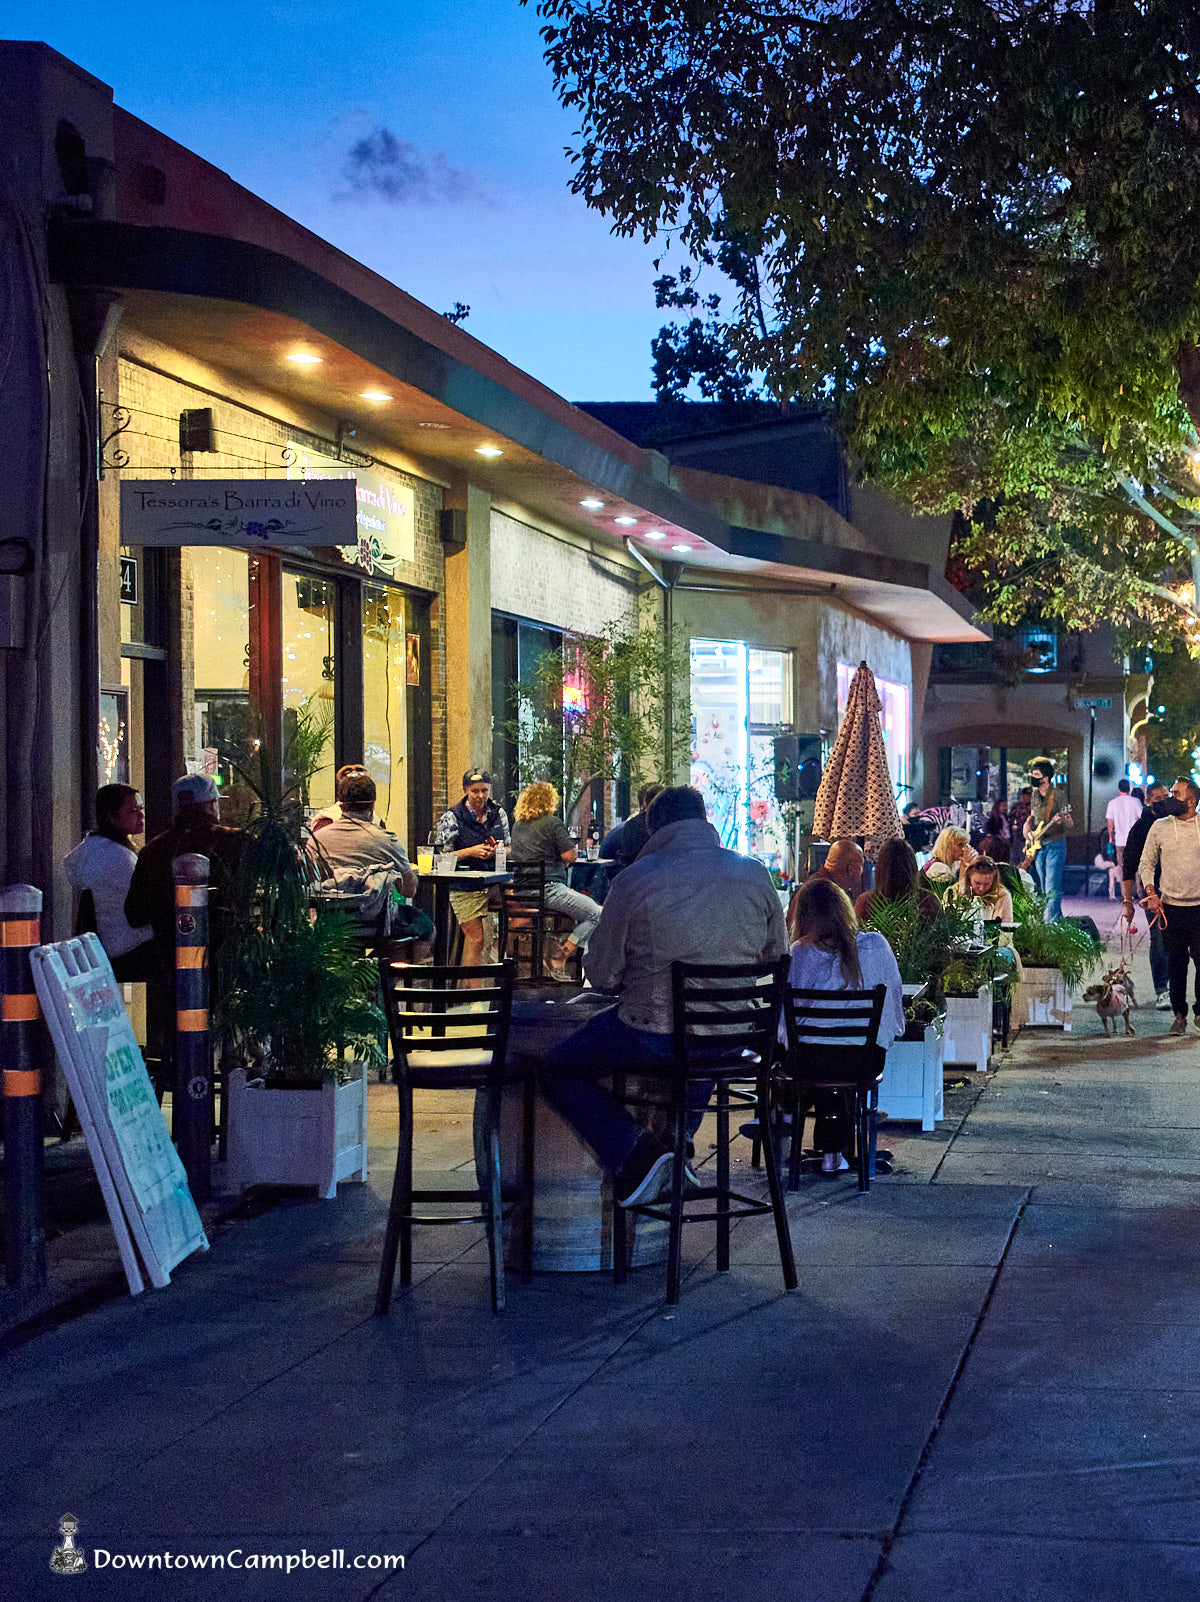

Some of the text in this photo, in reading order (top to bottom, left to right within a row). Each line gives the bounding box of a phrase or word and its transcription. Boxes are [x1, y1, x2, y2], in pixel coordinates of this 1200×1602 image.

[133, 490, 346, 511] Tessora's Barra di Vino
[120, 564, 132, 593] 4
